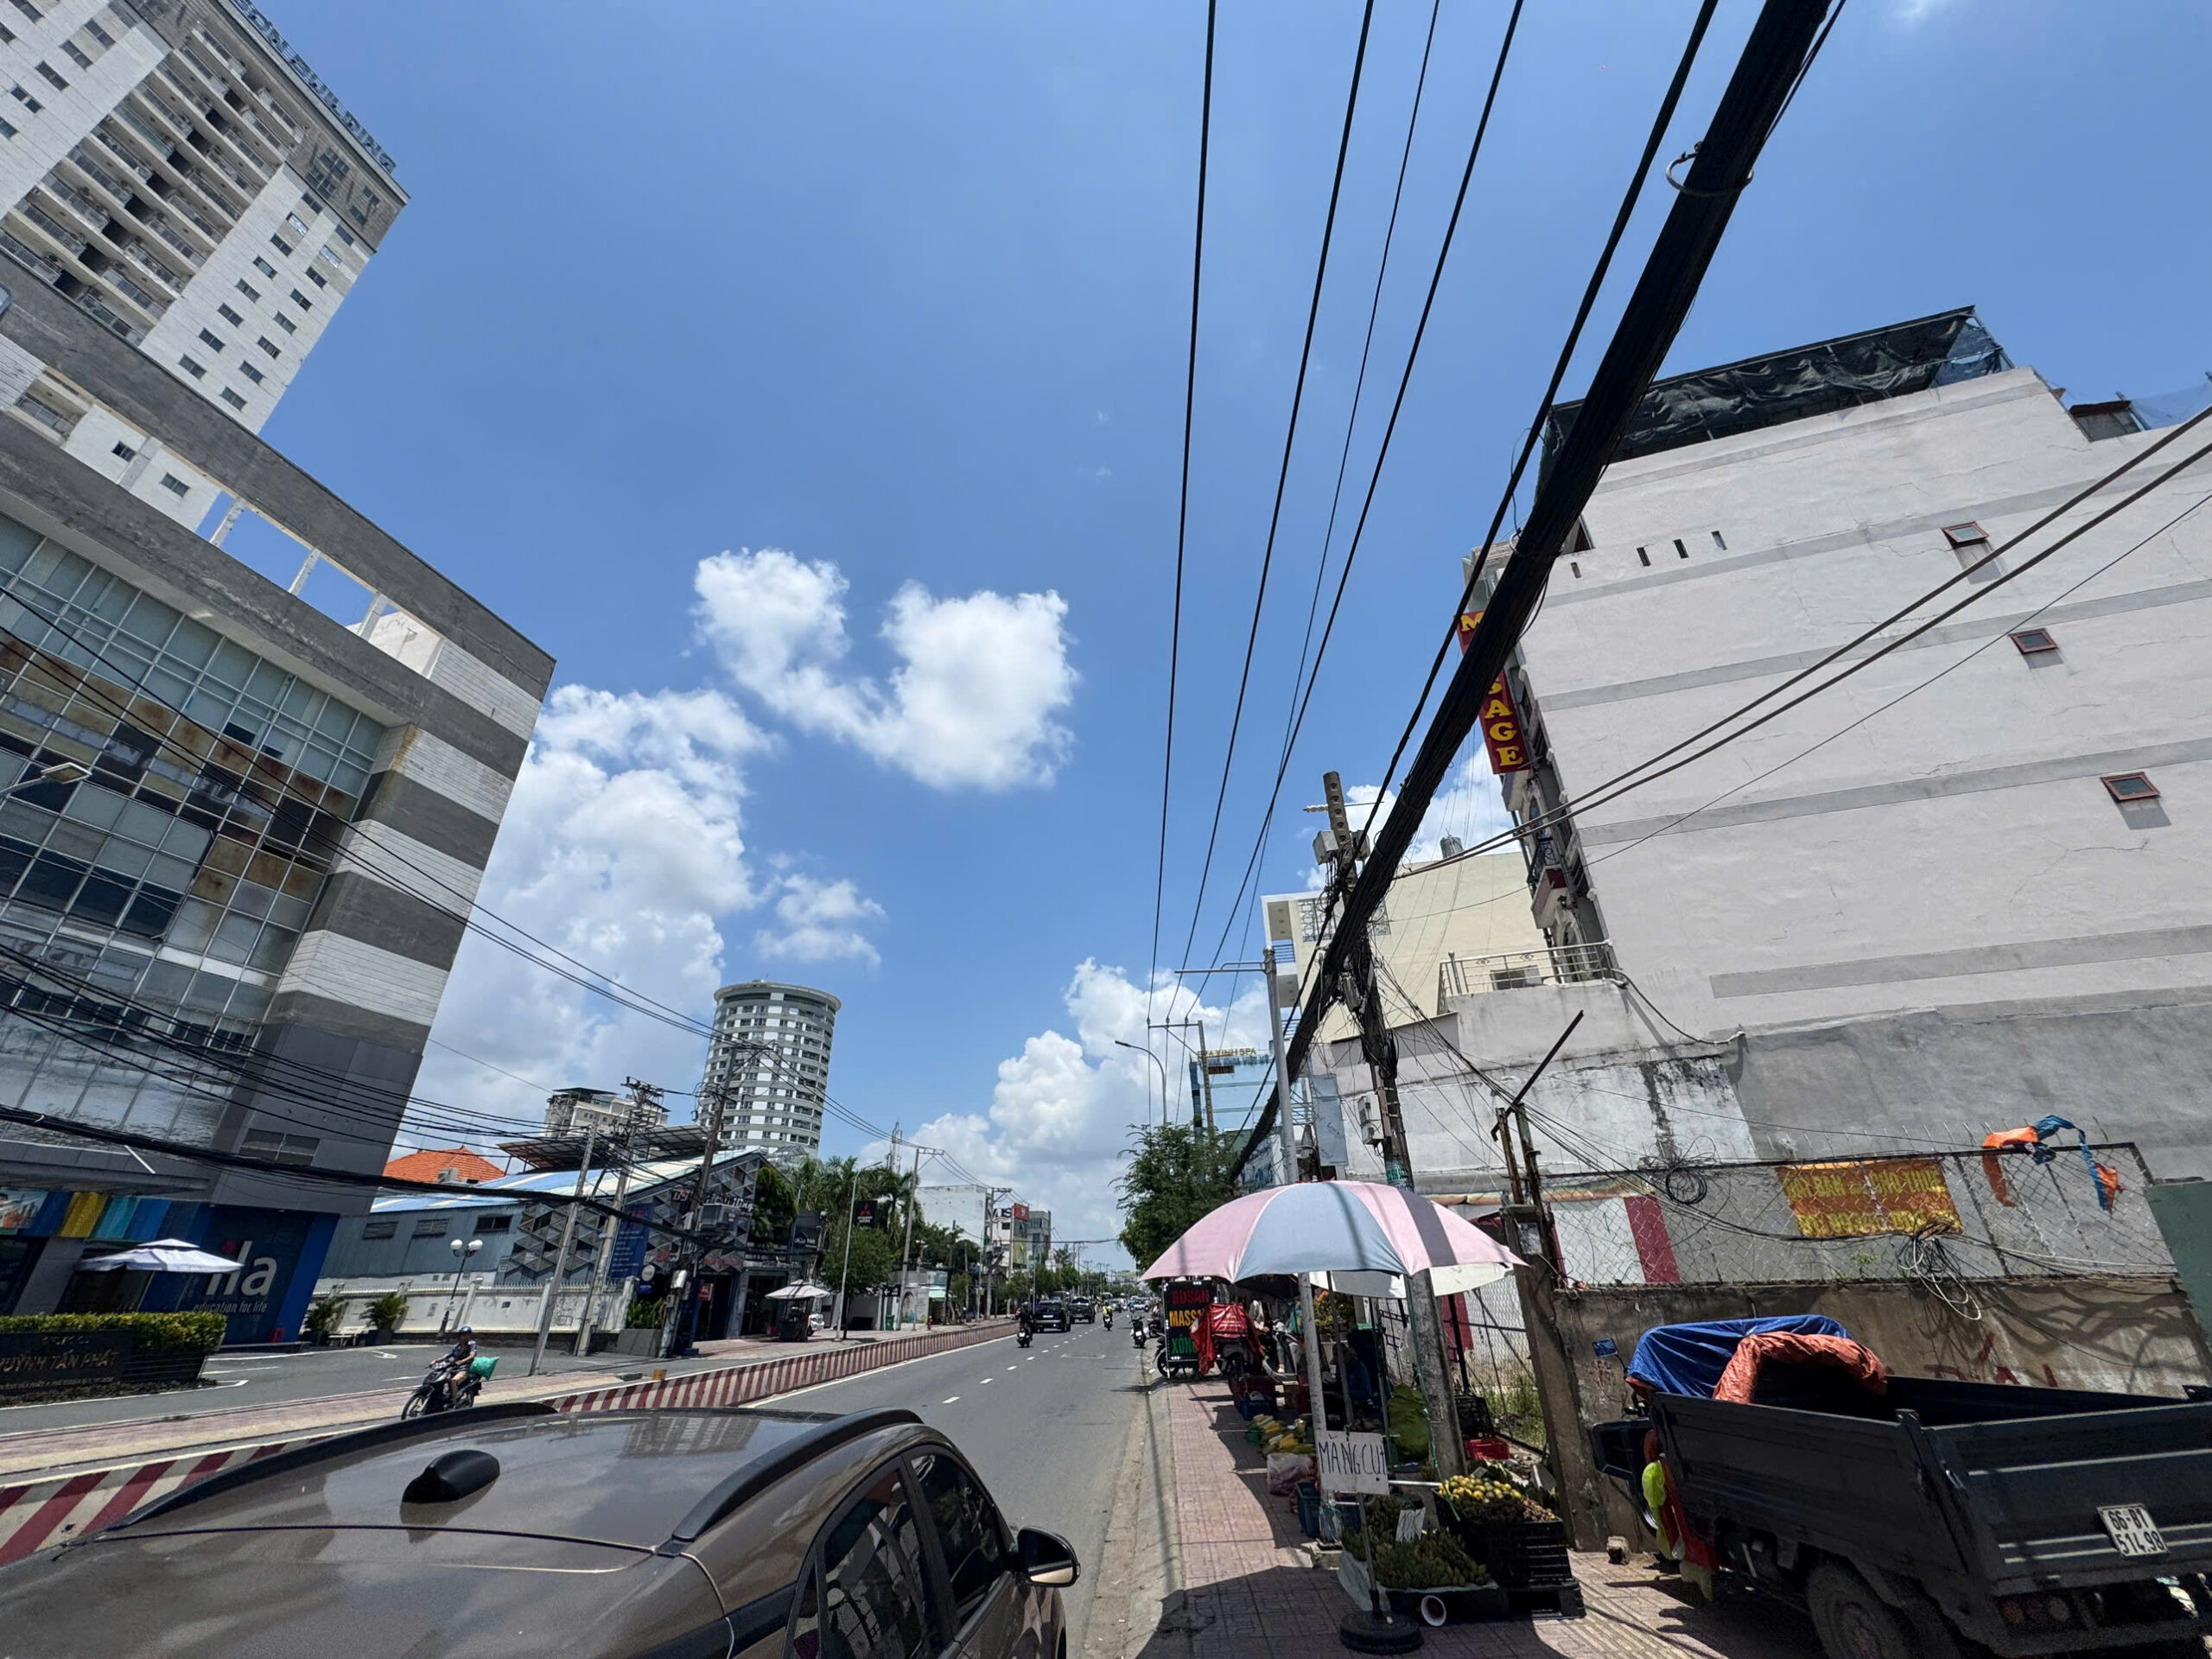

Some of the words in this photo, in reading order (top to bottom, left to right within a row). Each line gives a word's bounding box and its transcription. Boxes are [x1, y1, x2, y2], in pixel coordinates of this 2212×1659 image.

[1460, 612, 1524, 767] MSAGE
[1239, 1047, 1257, 1056] SPA
[206, 1240, 278, 1297] ila
[238, 1300, 253, 1313] for
[254, 1300, 268, 1313] life
[1172, 1290, 1210, 1304] BUSAN
[1169, 1309, 1198, 1327] MASS
[2108, 1508, 2149, 1529] 66-B1
[2114, 1530, 2164, 1554] 514.98
